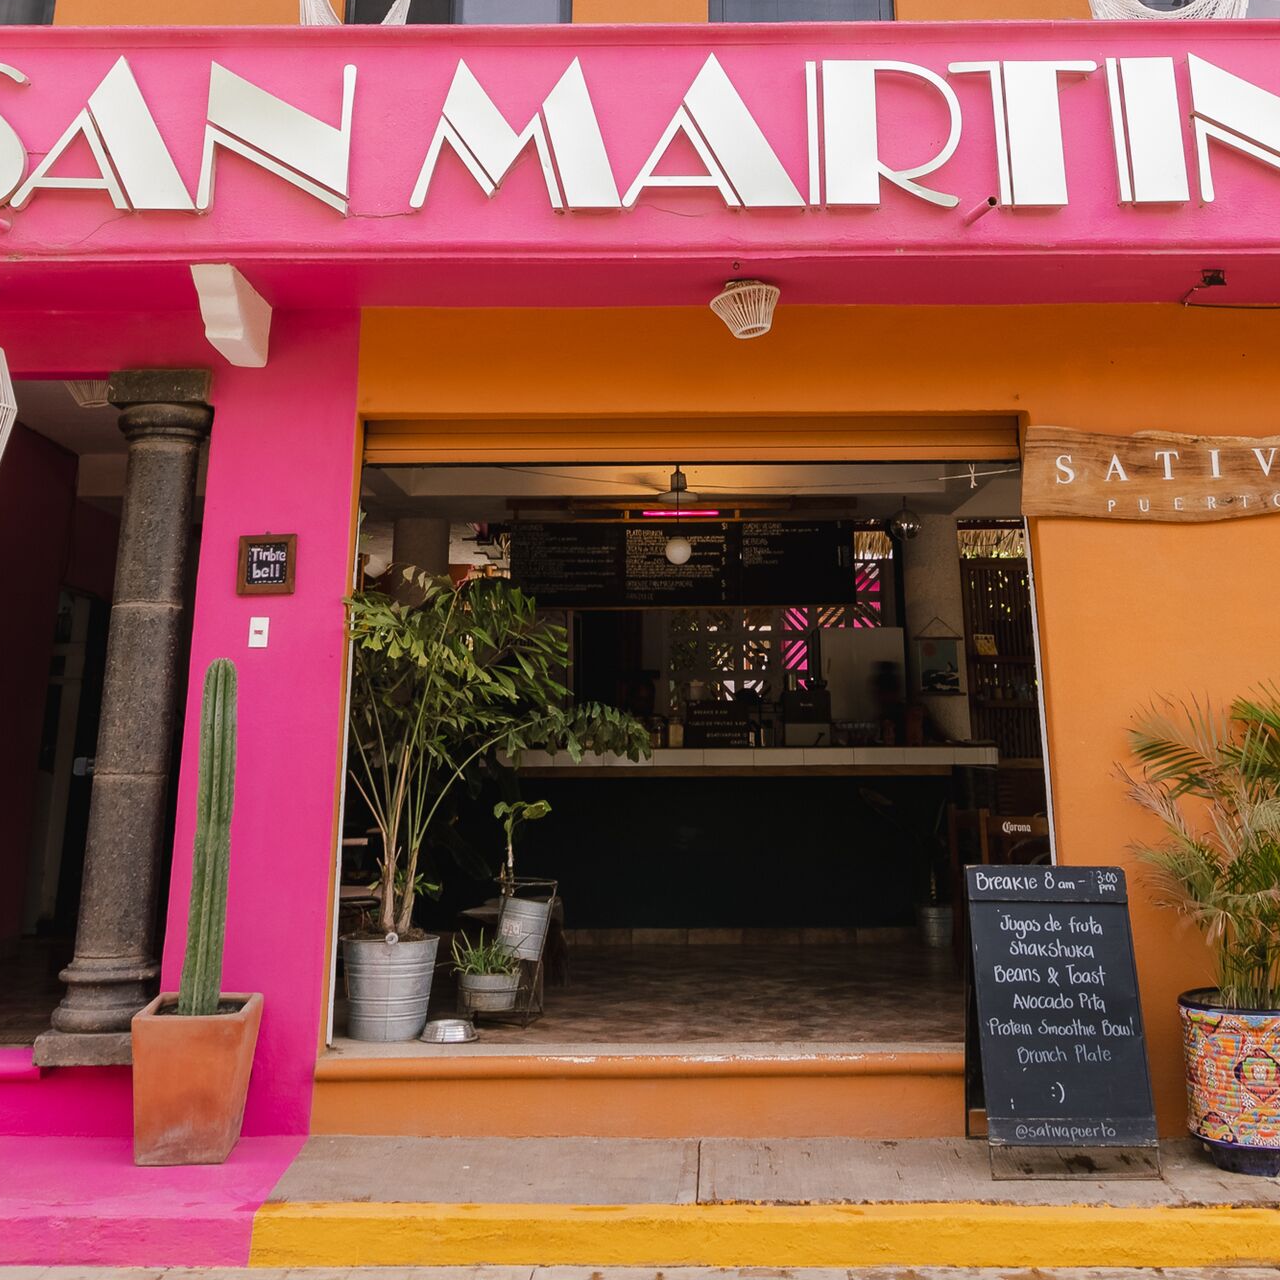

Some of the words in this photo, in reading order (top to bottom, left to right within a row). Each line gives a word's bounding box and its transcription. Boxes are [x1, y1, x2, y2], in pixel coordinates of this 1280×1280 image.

[251, 547, 287, 562] Timbre
[252, 563, 280, 578] bell
[1002, 821, 1032, 834] Corona
[1044, 871, 1055, 890] 8
[1058, 880, 1075, 890] am
[1096, 870, 1118, 884] 3:00
[1099, 883, 1116, 895] pm
[1000, 914, 1041, 940] Jugos
[1044, 913, 1062, 932] de
[1068, 915, 1103, 936] fruta
[993, 964, 1041, 984] Beans
[1047, 966, 1060, 987] &
[1066, 963, 1107, 986] Toast
[1013, 992, 1074, 1010] Avocado
[1078, 992, 1106, 1013] Pita
[988, 1017, 1033, 1036] Protein
[1038, 1018, 1097, 1037] Smoothie
[1101, 1016, 1135, 1036] Bowl
[1017, 1046, 1068, 1064] Brunch
[1075, 1043, 1112, 1064] Plate
[1015, 1122, 1117, 1142] @sativapuerto
